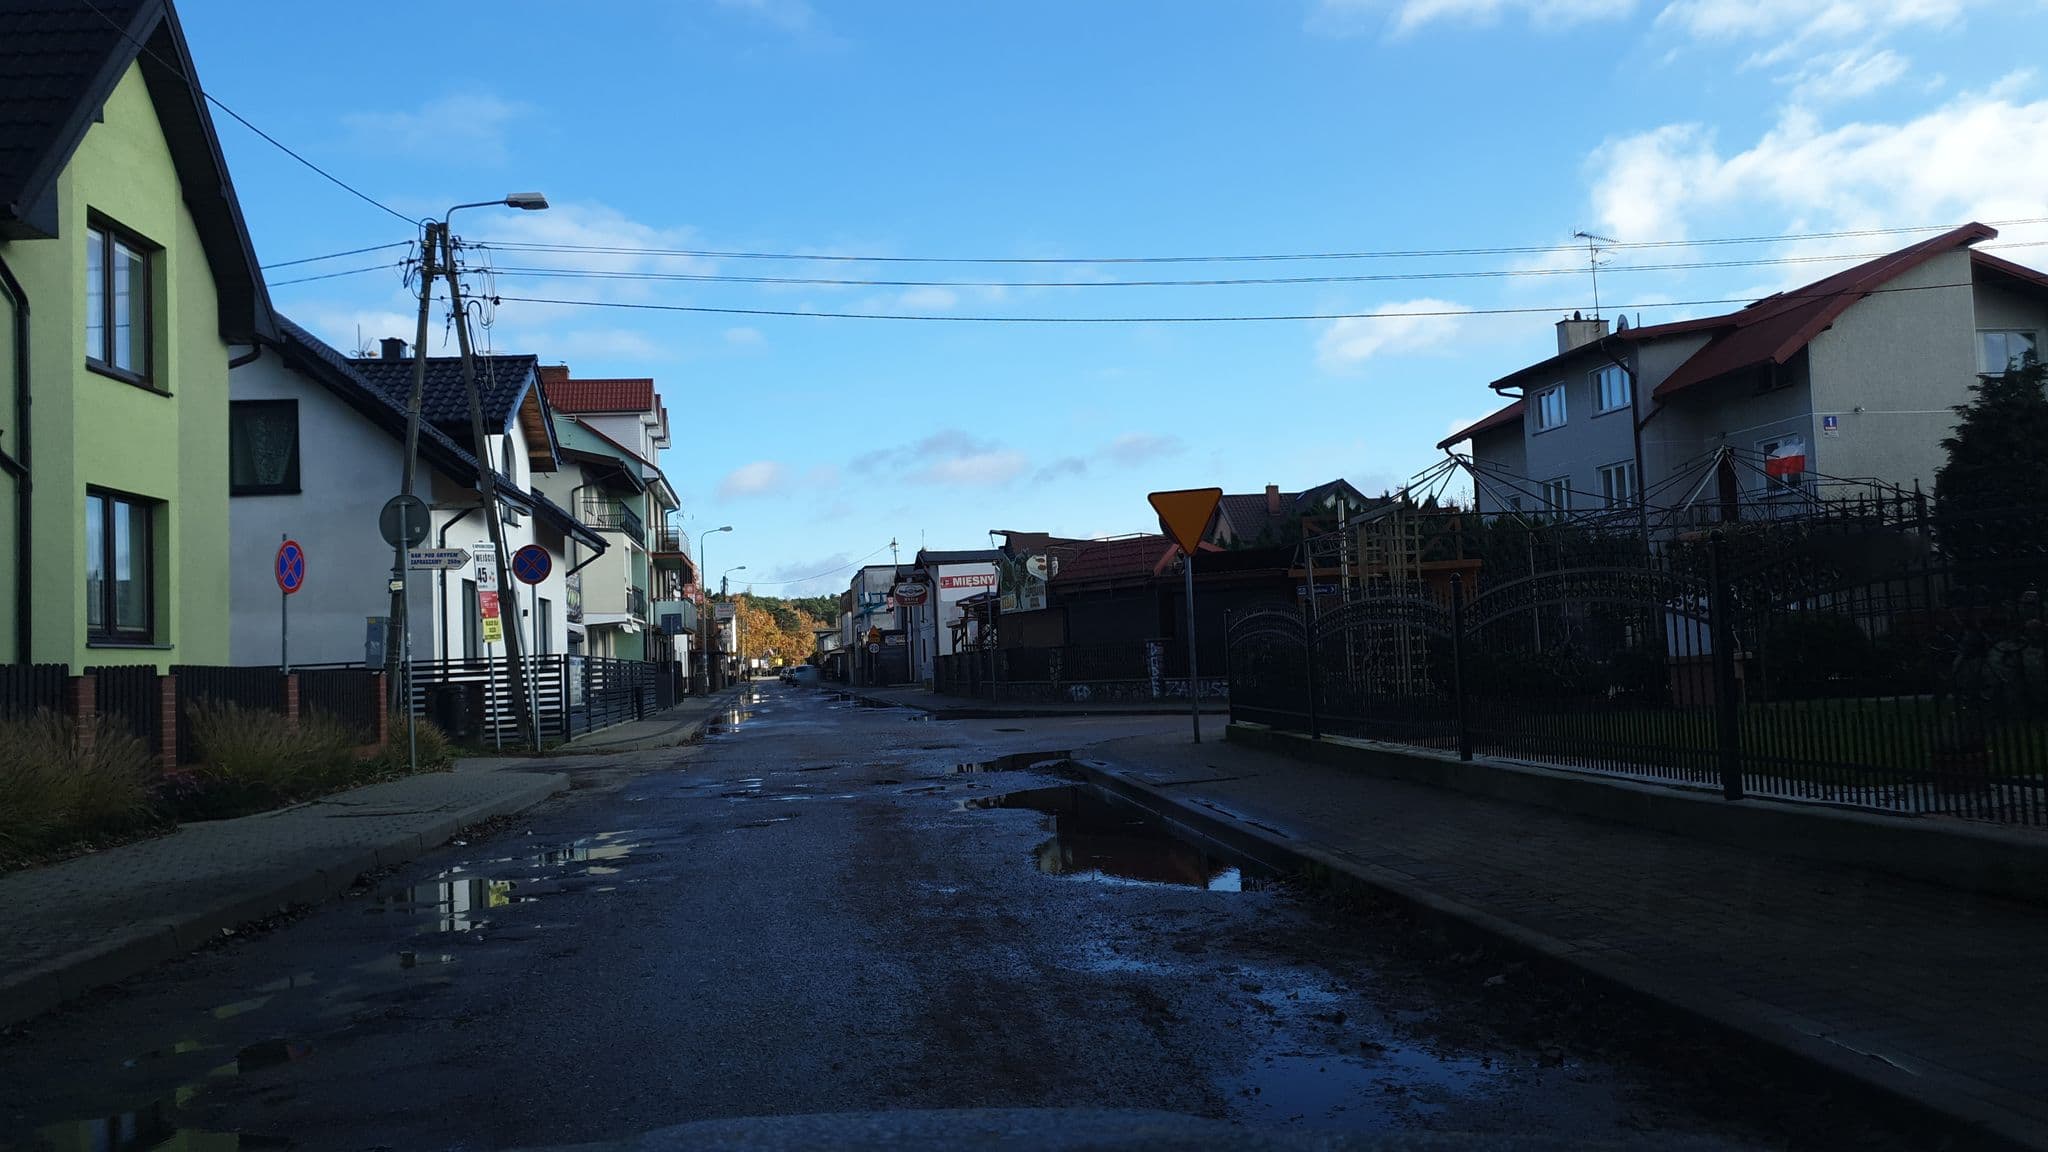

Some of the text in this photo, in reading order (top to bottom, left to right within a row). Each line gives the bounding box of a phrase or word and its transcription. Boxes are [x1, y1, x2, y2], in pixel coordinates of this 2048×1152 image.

[1828, 416, 1832, 427] 1
[478, 568, 488, 583] 45
[952, 575, 994, 587] MIĘSNY
